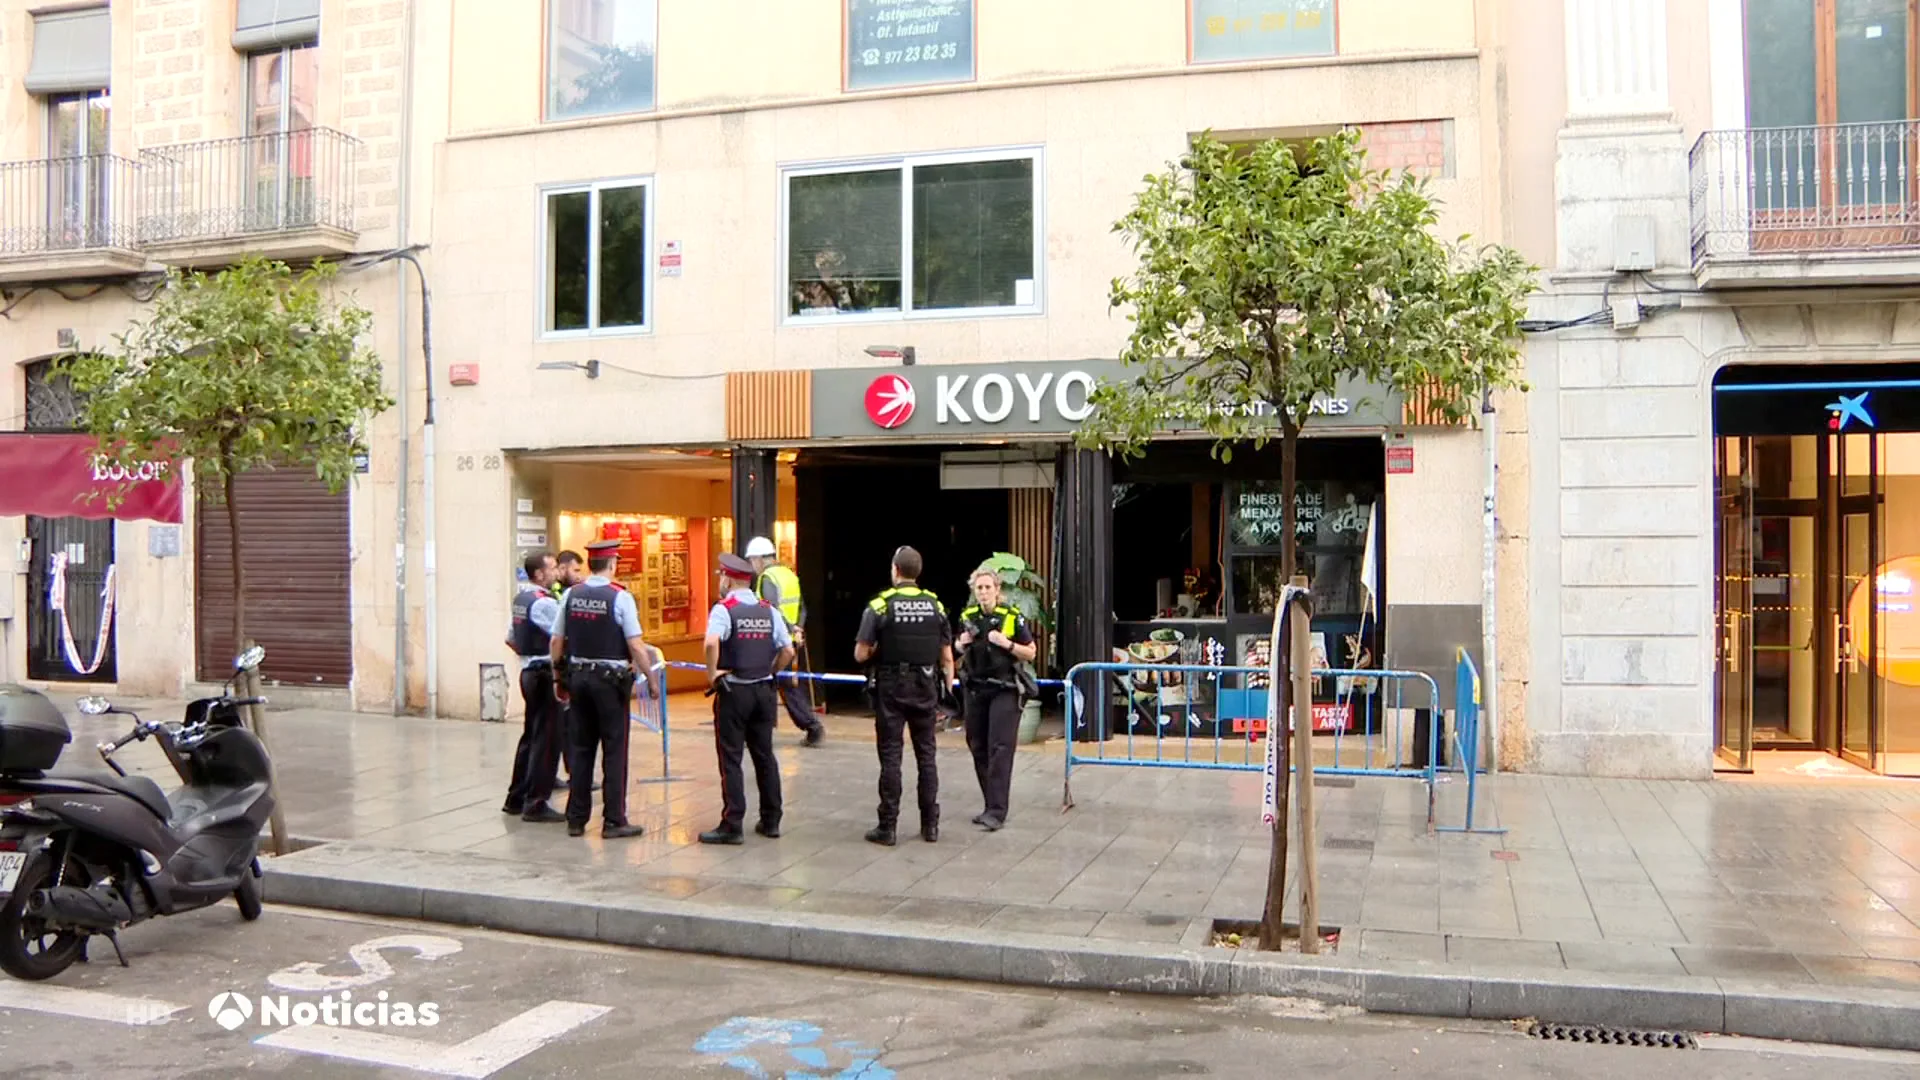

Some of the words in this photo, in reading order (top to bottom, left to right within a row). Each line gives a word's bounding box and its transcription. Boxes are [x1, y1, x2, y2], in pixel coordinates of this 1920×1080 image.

[884, 50, 903, 64] 977
[905, 46, 921, 62] 23
[922, 44, 939, 60] 82
[940, 42, 957, 59] 35
[936, 370, 1098, 424] KOYO
[456, 455, 474, 471] 26
[483, 455, 501, 470] 28
[1240, 494, 1303, 505] FINESTA
[1306, 493, 1323, 504] DE
[1241, 507, 1292, 519] MENJA
[1297, 507, 1323, 518] PER
[1250, 522, 1260, 533] A
[1262, 521, 1315, 533] POAR
[571, 598, 607, 610] POLICIA
[894, 600, 934, 611] POLICIA
[737, 618, 772, 628] POLICIA
